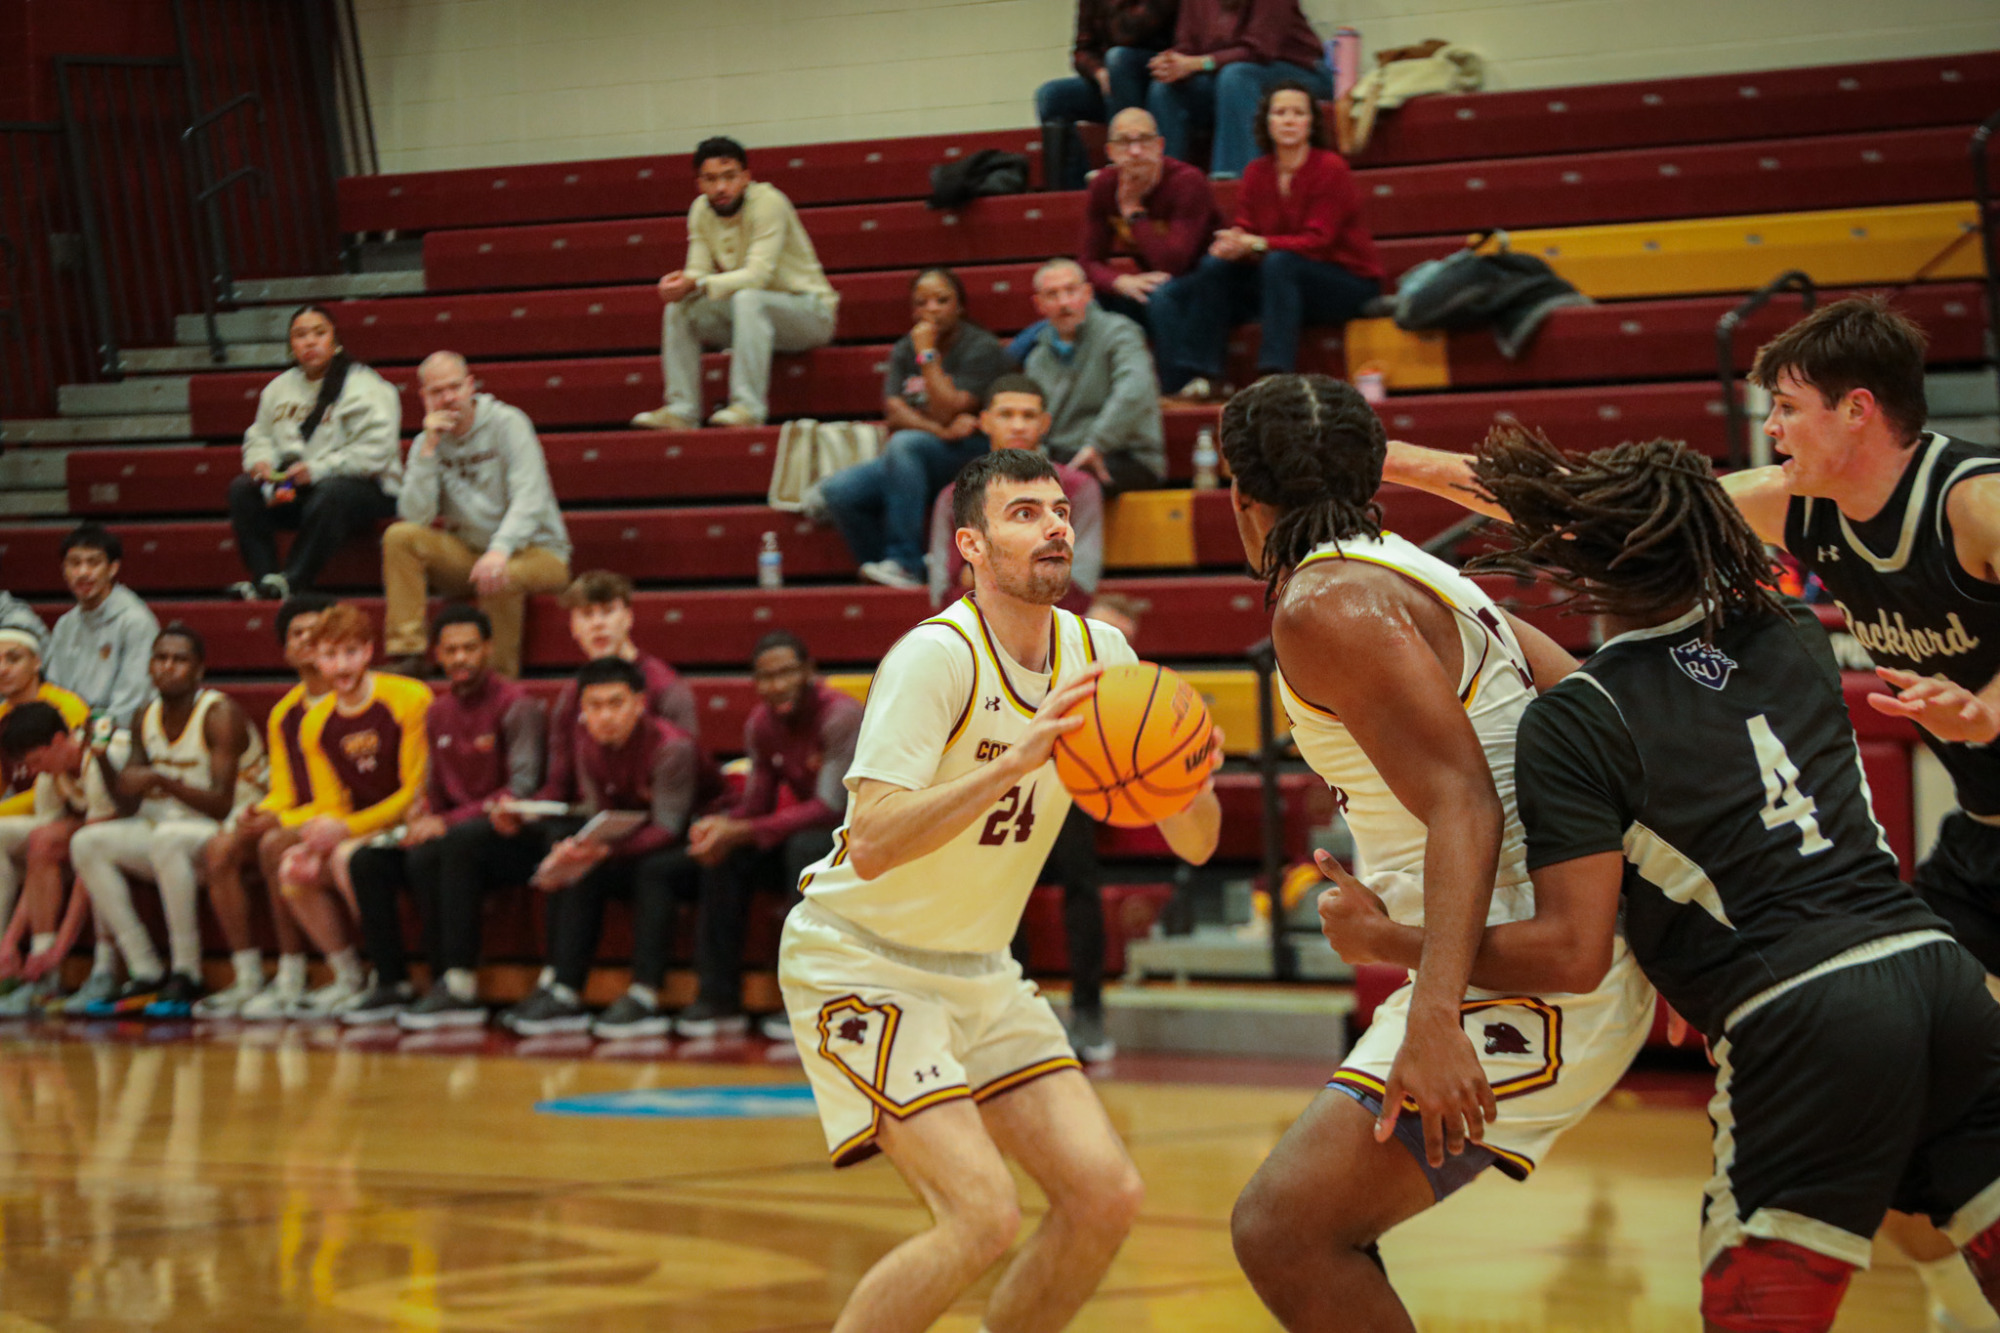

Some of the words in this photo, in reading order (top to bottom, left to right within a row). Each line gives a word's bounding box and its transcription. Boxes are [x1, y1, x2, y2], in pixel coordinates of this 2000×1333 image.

[1685, 660, 1721, 680] RU
[978, 780, 1037, 846] 24
[1746, 714, 1834, 856] 4
